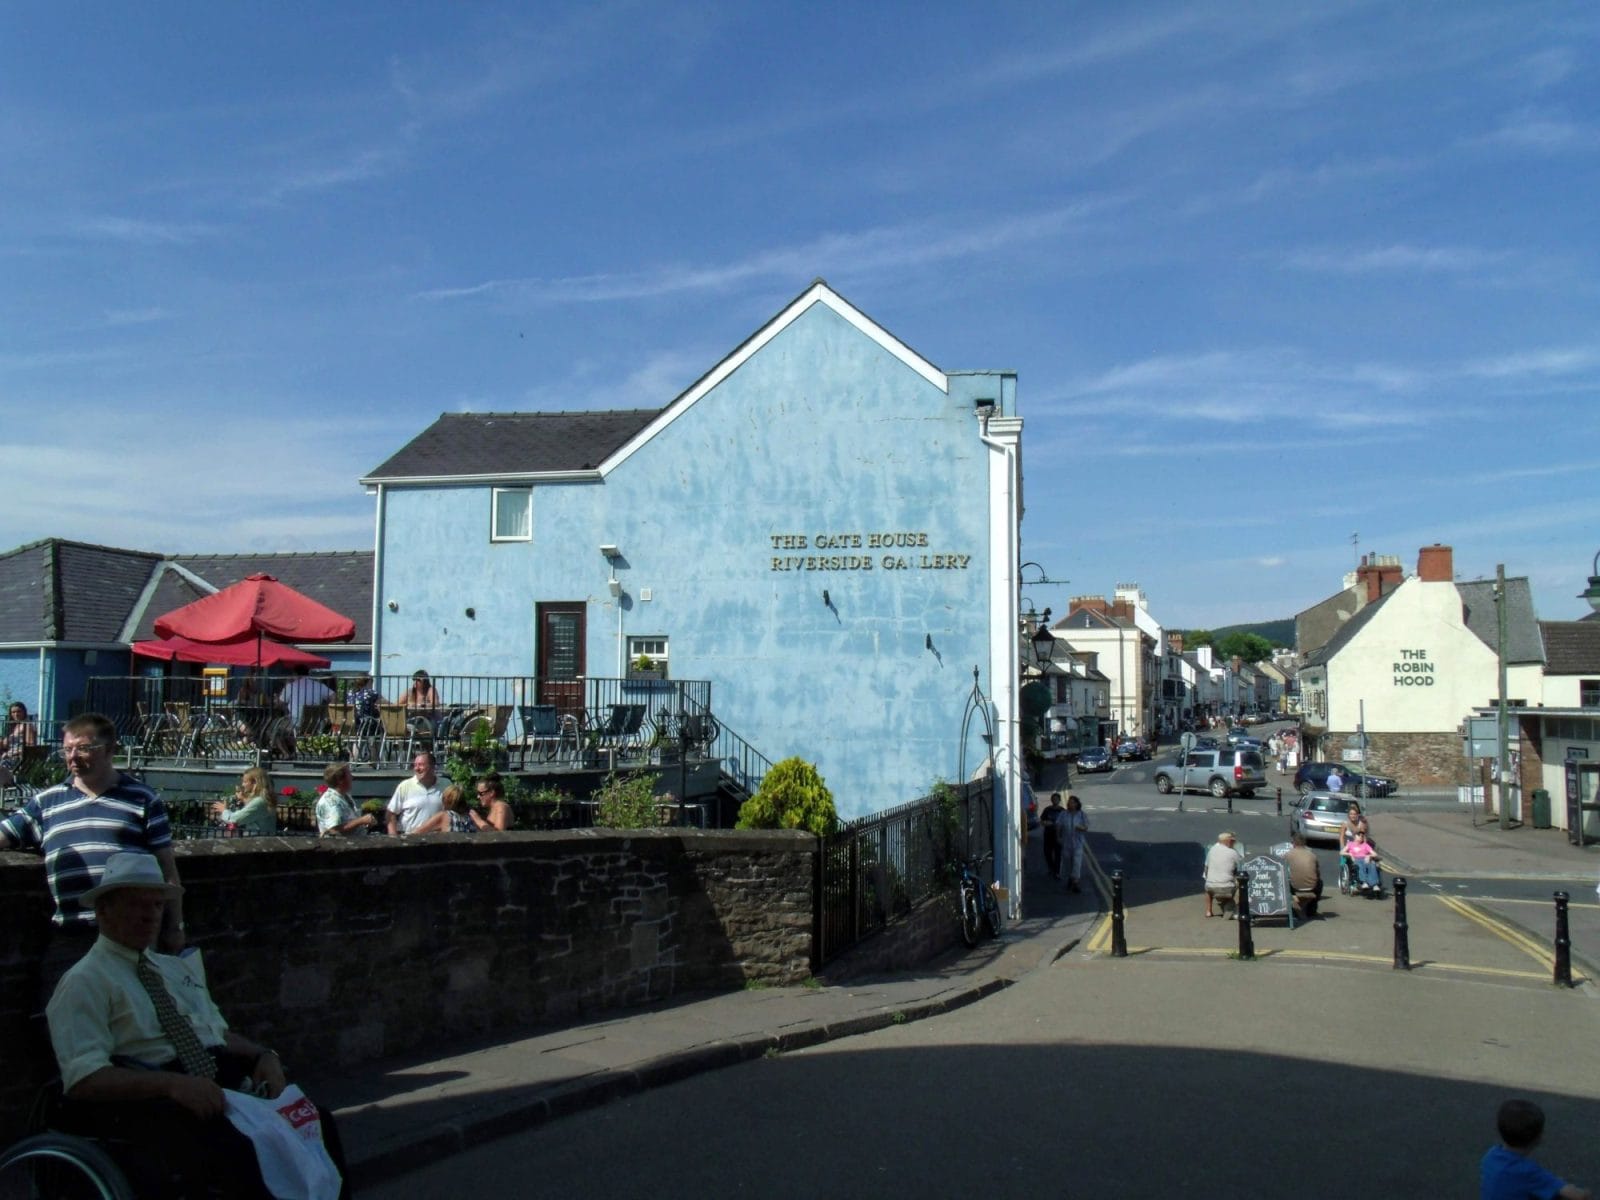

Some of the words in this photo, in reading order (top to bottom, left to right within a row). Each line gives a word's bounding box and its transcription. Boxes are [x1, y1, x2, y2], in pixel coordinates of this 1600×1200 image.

[770, 535, 808, 549] THE
[814, 534, 863, 549] GATE
[868, 533, 929, 548] HOUSE
[770, 556, 873, 571] RIVERSIDE
[881, 554, 972, 570] GALERY
[1400, 649, 1426, 659] THE
[1393, 662, 1434, 673] ROBIN
[1393, 676, 1434, 686] HOOD
